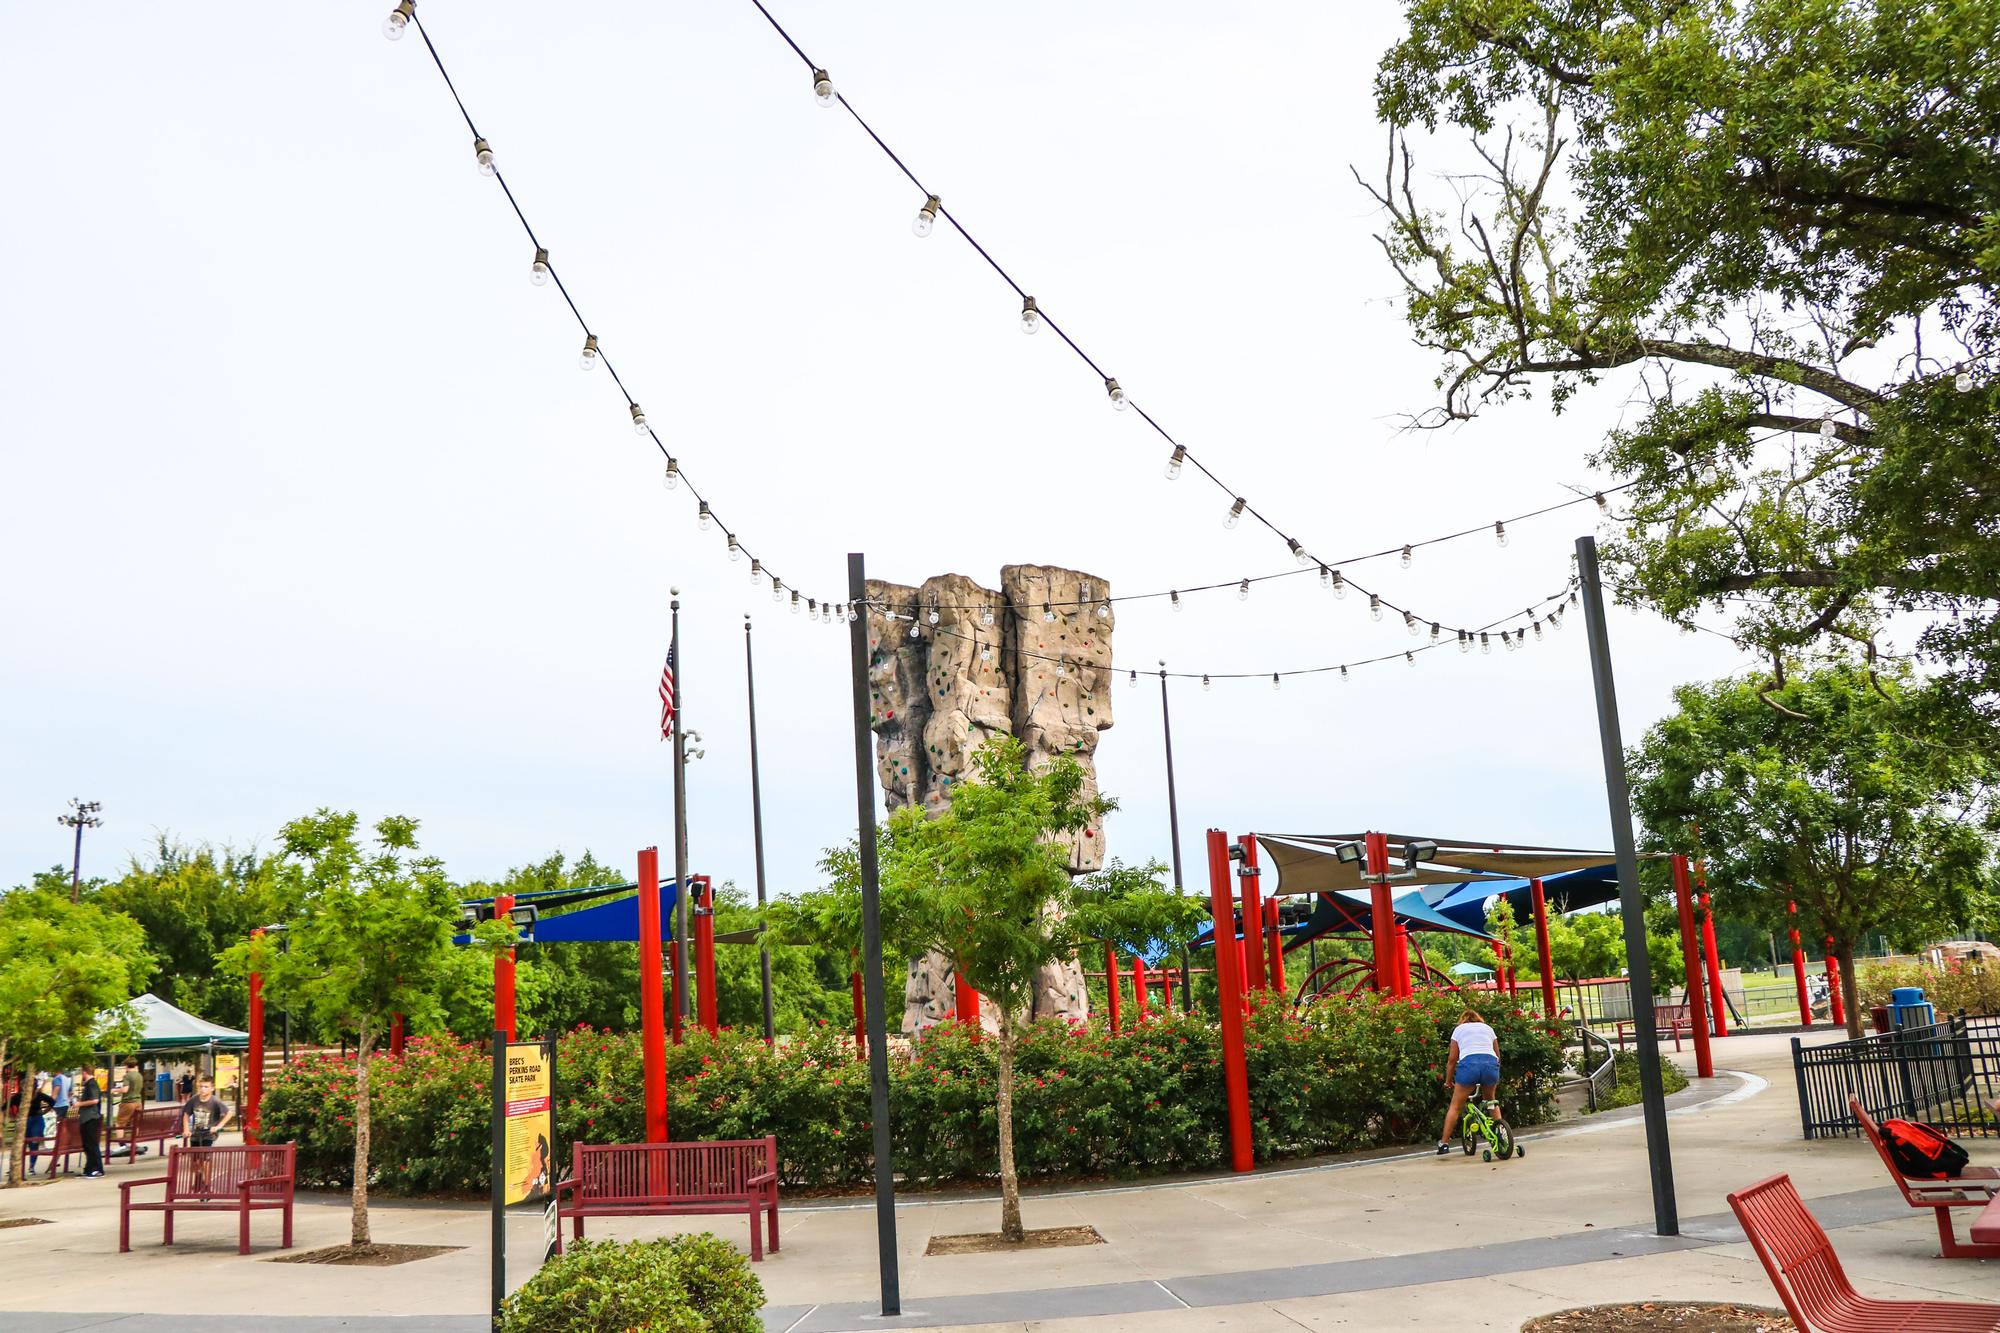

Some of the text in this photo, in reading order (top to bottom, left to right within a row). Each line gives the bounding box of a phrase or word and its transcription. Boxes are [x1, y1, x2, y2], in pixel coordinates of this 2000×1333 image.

[509, 1066, 528, 1074] PERKINS
[509, 1074, 536, 1084] SKATE PARK
